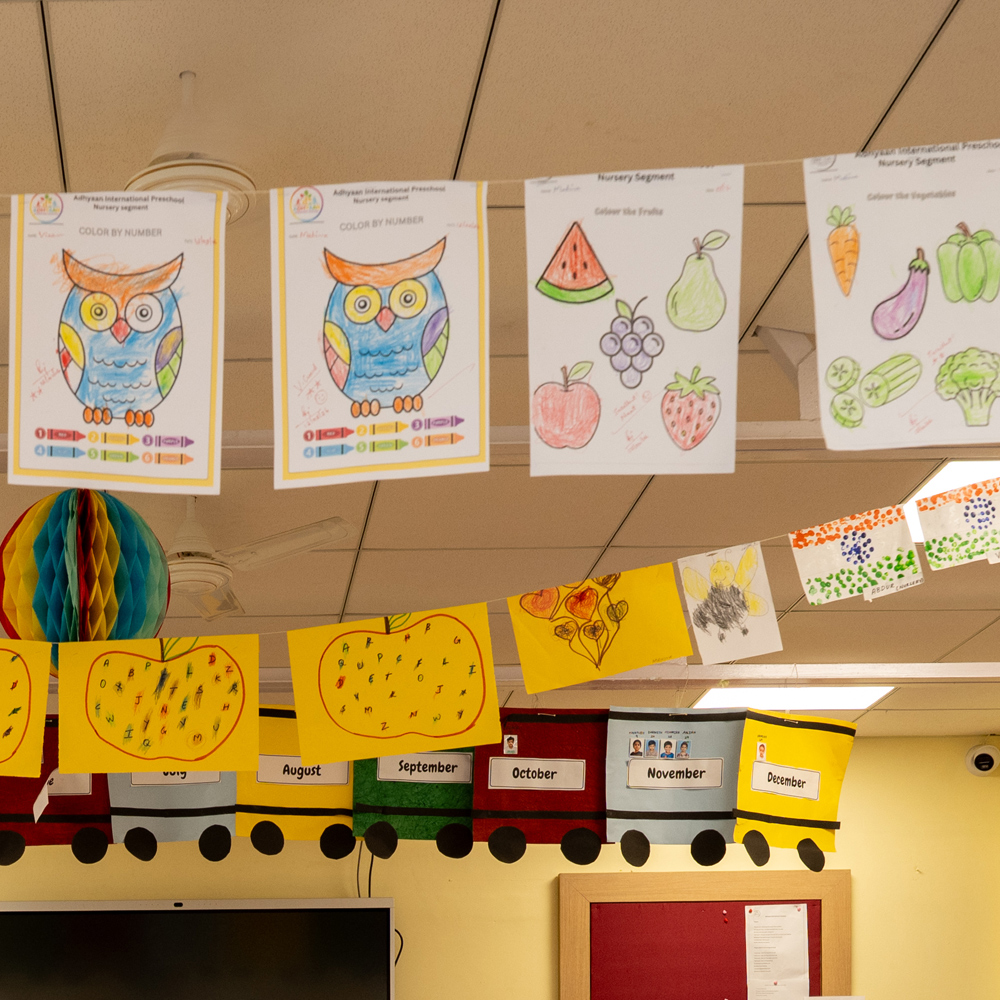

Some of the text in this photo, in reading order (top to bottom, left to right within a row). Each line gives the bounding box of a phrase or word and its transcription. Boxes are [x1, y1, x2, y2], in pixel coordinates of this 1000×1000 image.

[878, 155, 956, 168] Nursery Segment
[598, 172, 675, 183] Nursery Segment
[333, 188, 363, 197] Adhyaan
[364, 187, 410, 196] International
[895, 191, 910, 200] the
[73, 195, 185, 204] Adhyaan International Preschool
[353, 196, 379, 204] Nursery
[93, 204, 148, 212] Nursery segment
[594, 206, 663, 216] Colour the Fruits
[339, 216, 424, 231] COLOR BY NUMBER
[78, 227, 162, 237] COLOR BY NUMBER
[282, 764, 321, 779] August
[398, 760, 458, 775] September
[512, 767, 557, 779] October
[647, 767, 706, 779] November
[768, 771, 806, 788] December
